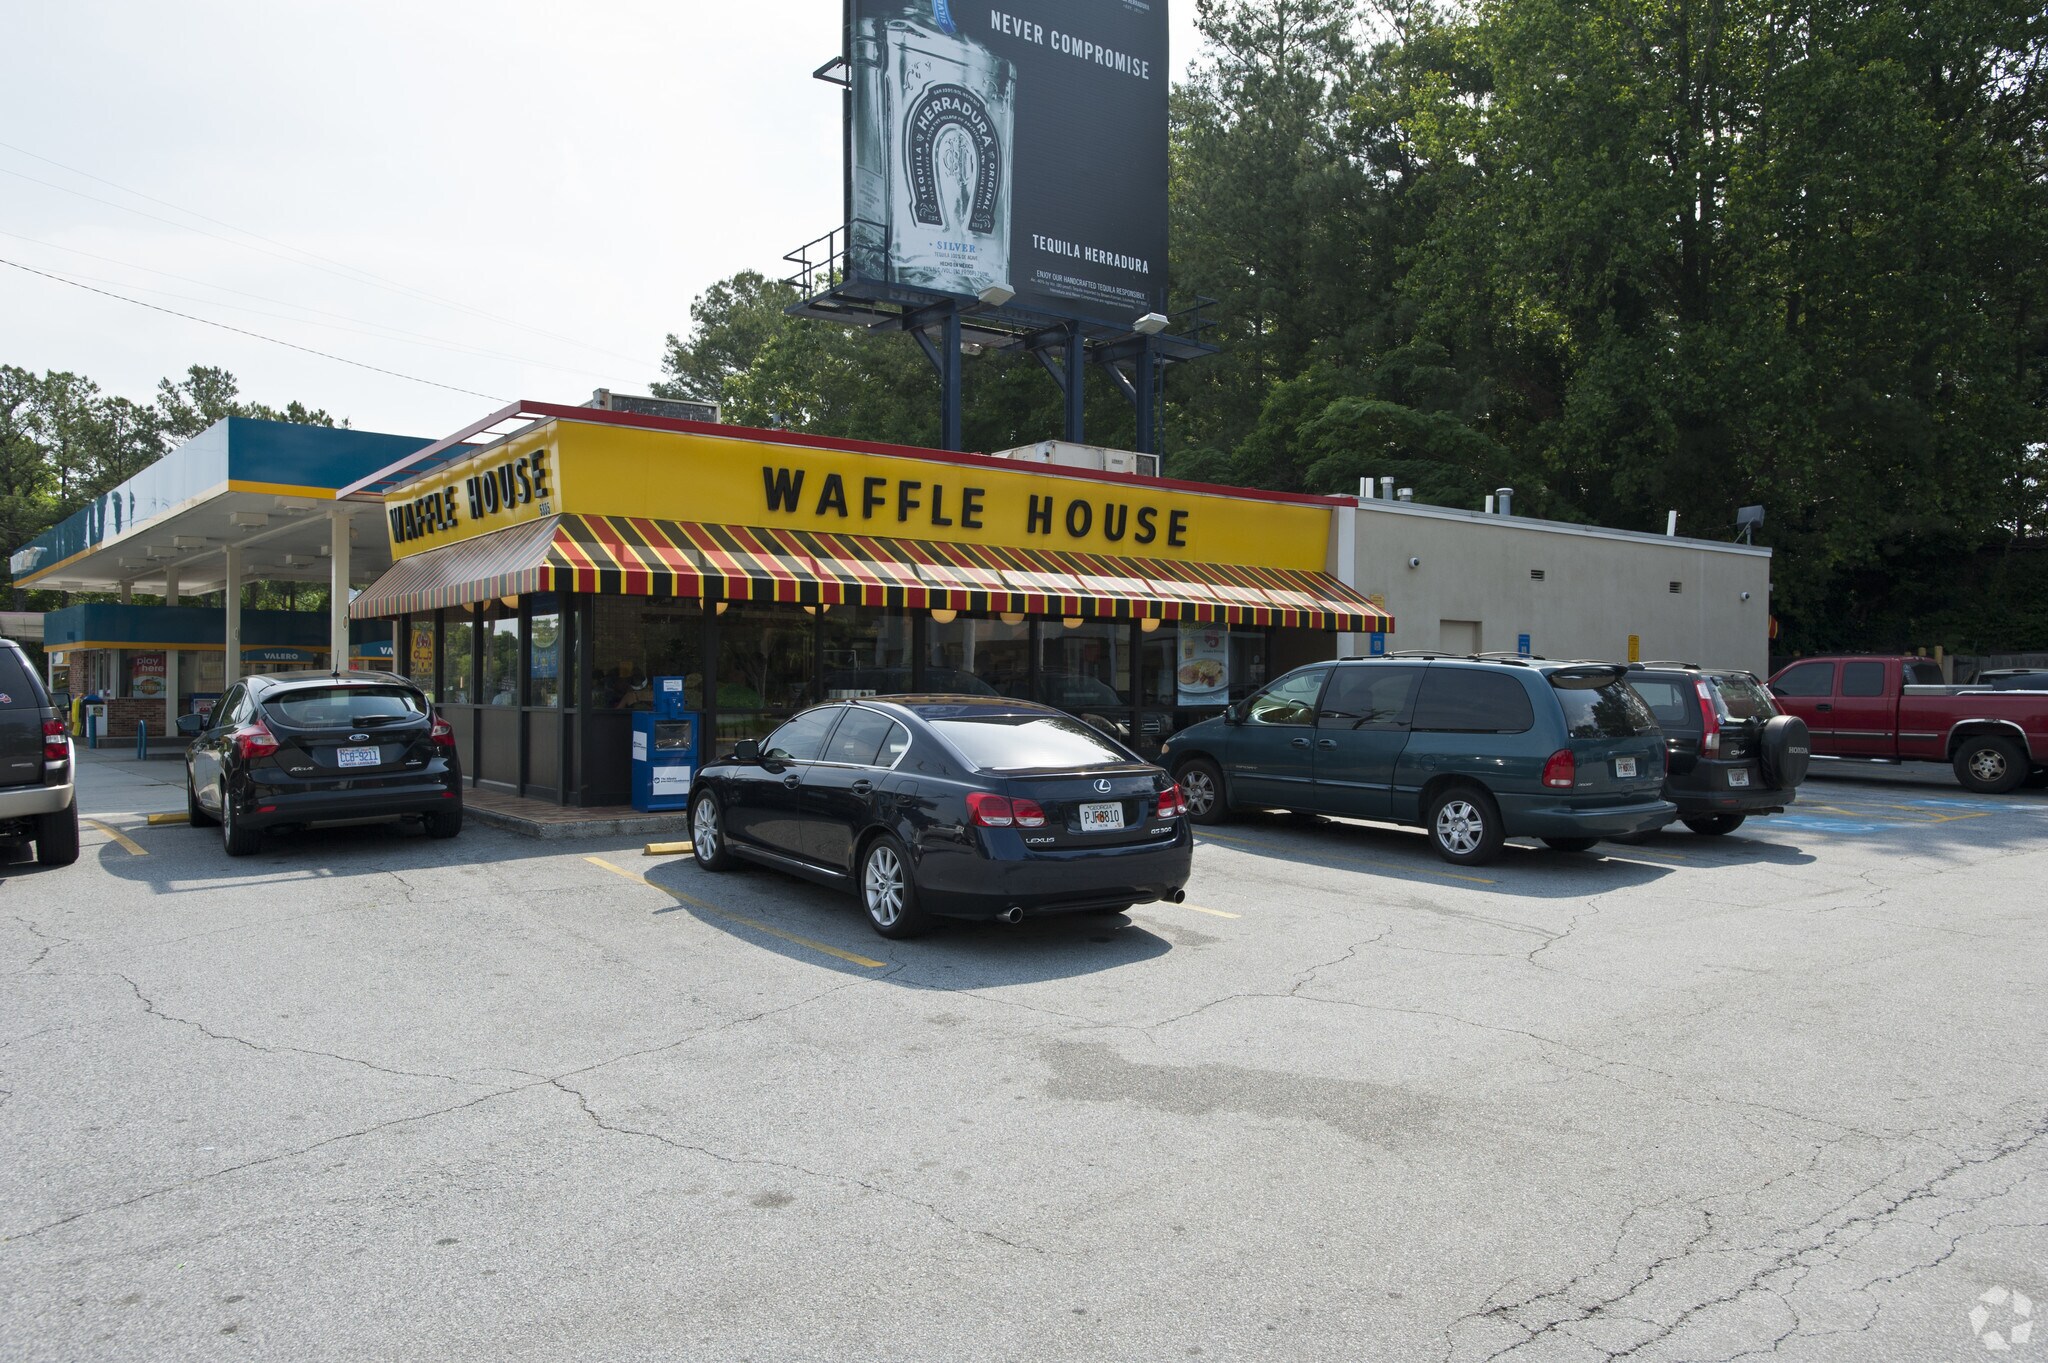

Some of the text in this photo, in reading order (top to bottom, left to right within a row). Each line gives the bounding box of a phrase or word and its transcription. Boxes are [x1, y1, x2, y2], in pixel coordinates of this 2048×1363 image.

[991, 9, 1149, 80] NEVER COMPROMISE
[917, 97, 992, 147] HERRADURA
[916, 147, 928, 200] TEQUILA
[982, 162, 996, 210] ORIGINAL
[936, 240, 976, 253] SILVER
[1033, 234, 1149, 274] TEQUILA HERRADURA
[1036, 269, 1052, 280] ENJOY
[1052, 273, 1063, 281] OUR
[1063, 275, 1097, 290] HANDCRAFTED
[1097, 282, 1116, 293] TEQUILA
[389, 449, 550, 544] WAFFLE HOUSE
[762, 466, 1189, 547] WAFFLE HOUSE
[136, 657, 159, 666] play
[142, 664, 165, 672] here
[263, 652, 299, 660] VALERO
[1788, 746, 1809, 754] HONDA
[1084, 809, 1120, 825] PJF8810
